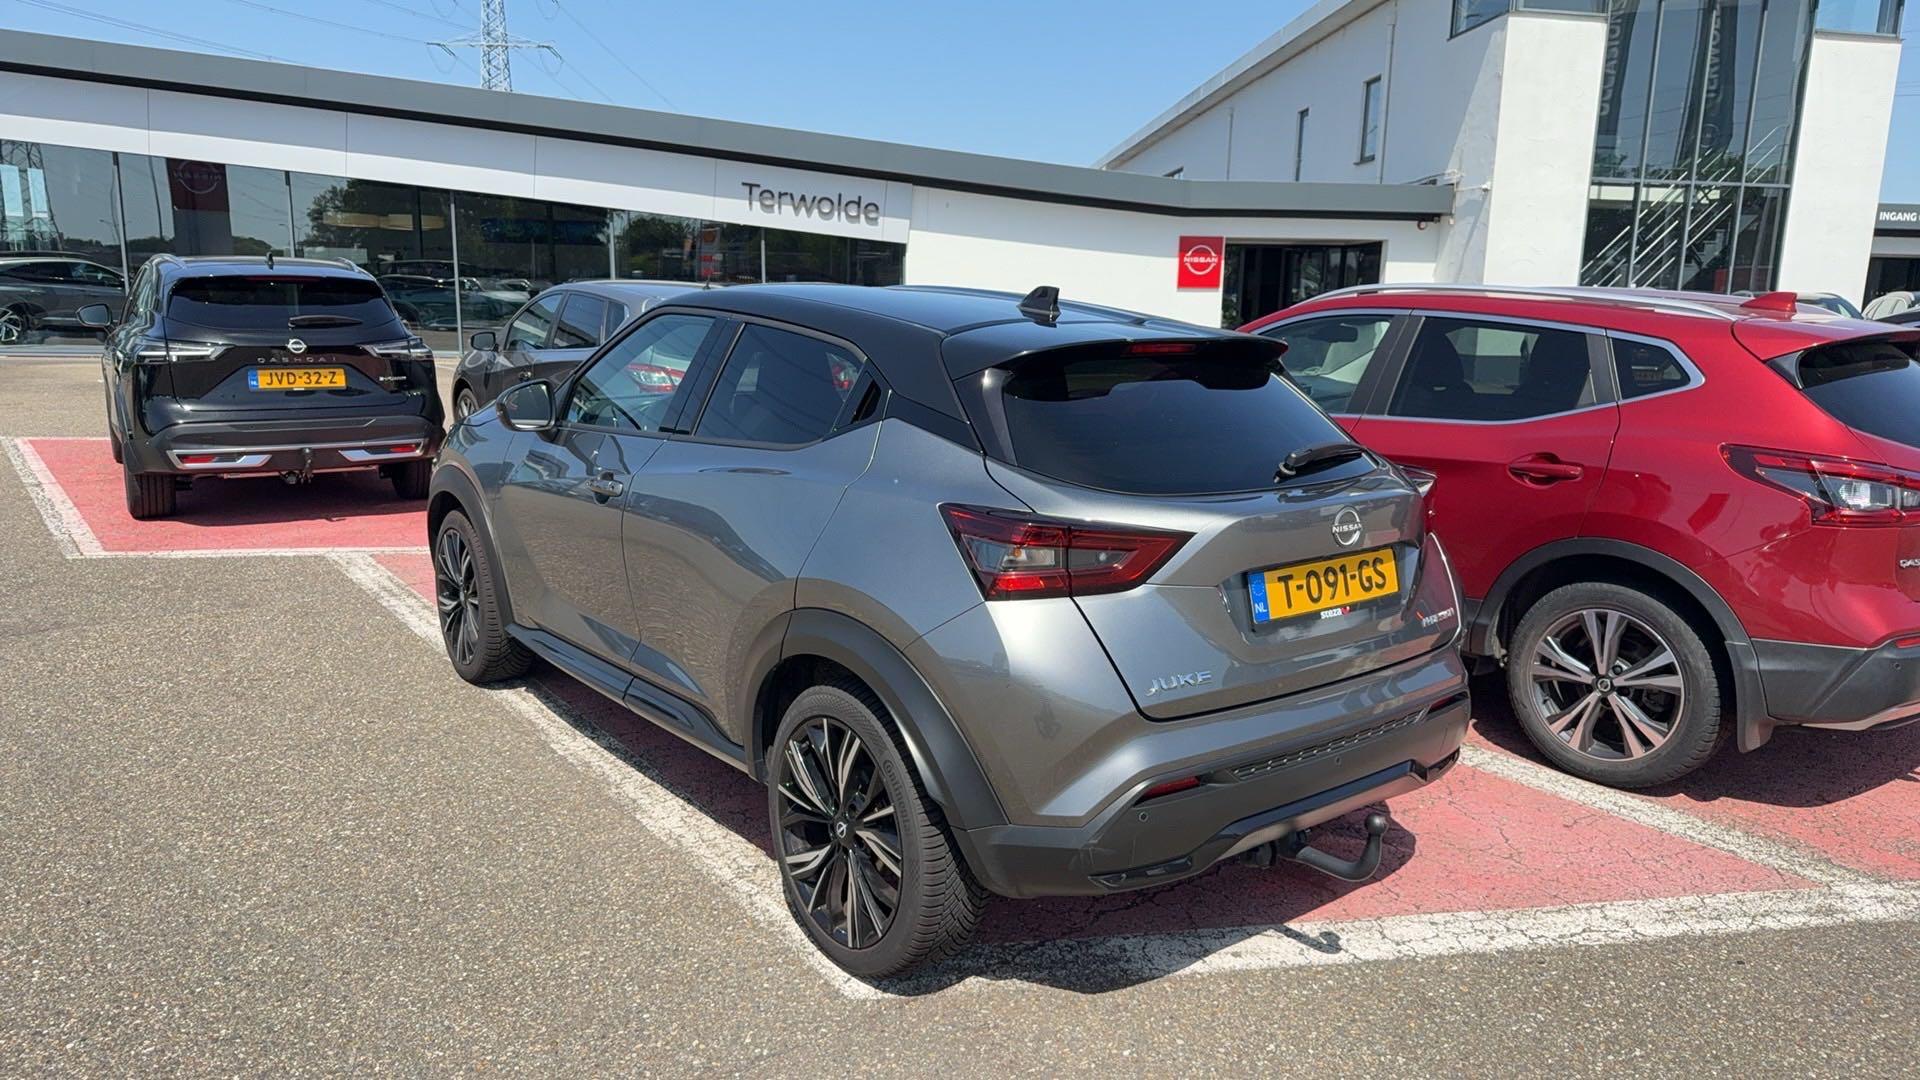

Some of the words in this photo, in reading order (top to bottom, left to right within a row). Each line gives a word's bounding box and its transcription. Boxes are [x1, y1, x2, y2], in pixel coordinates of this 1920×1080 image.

[741, 182, 879, 223] Terwolde
[1880, 211, 1917, 221] INGANG
[257, 356, 336, 364] QASHQAI
[266, 371, 337, 385] JVD-32-Z
[1332, 523, 1363, 533] NISSAN
[1277, 557, 1387, 609] T-091-GS
[1255, 602, 1267, 613] NL
[1146, 671, 1213, 696] JUKE
